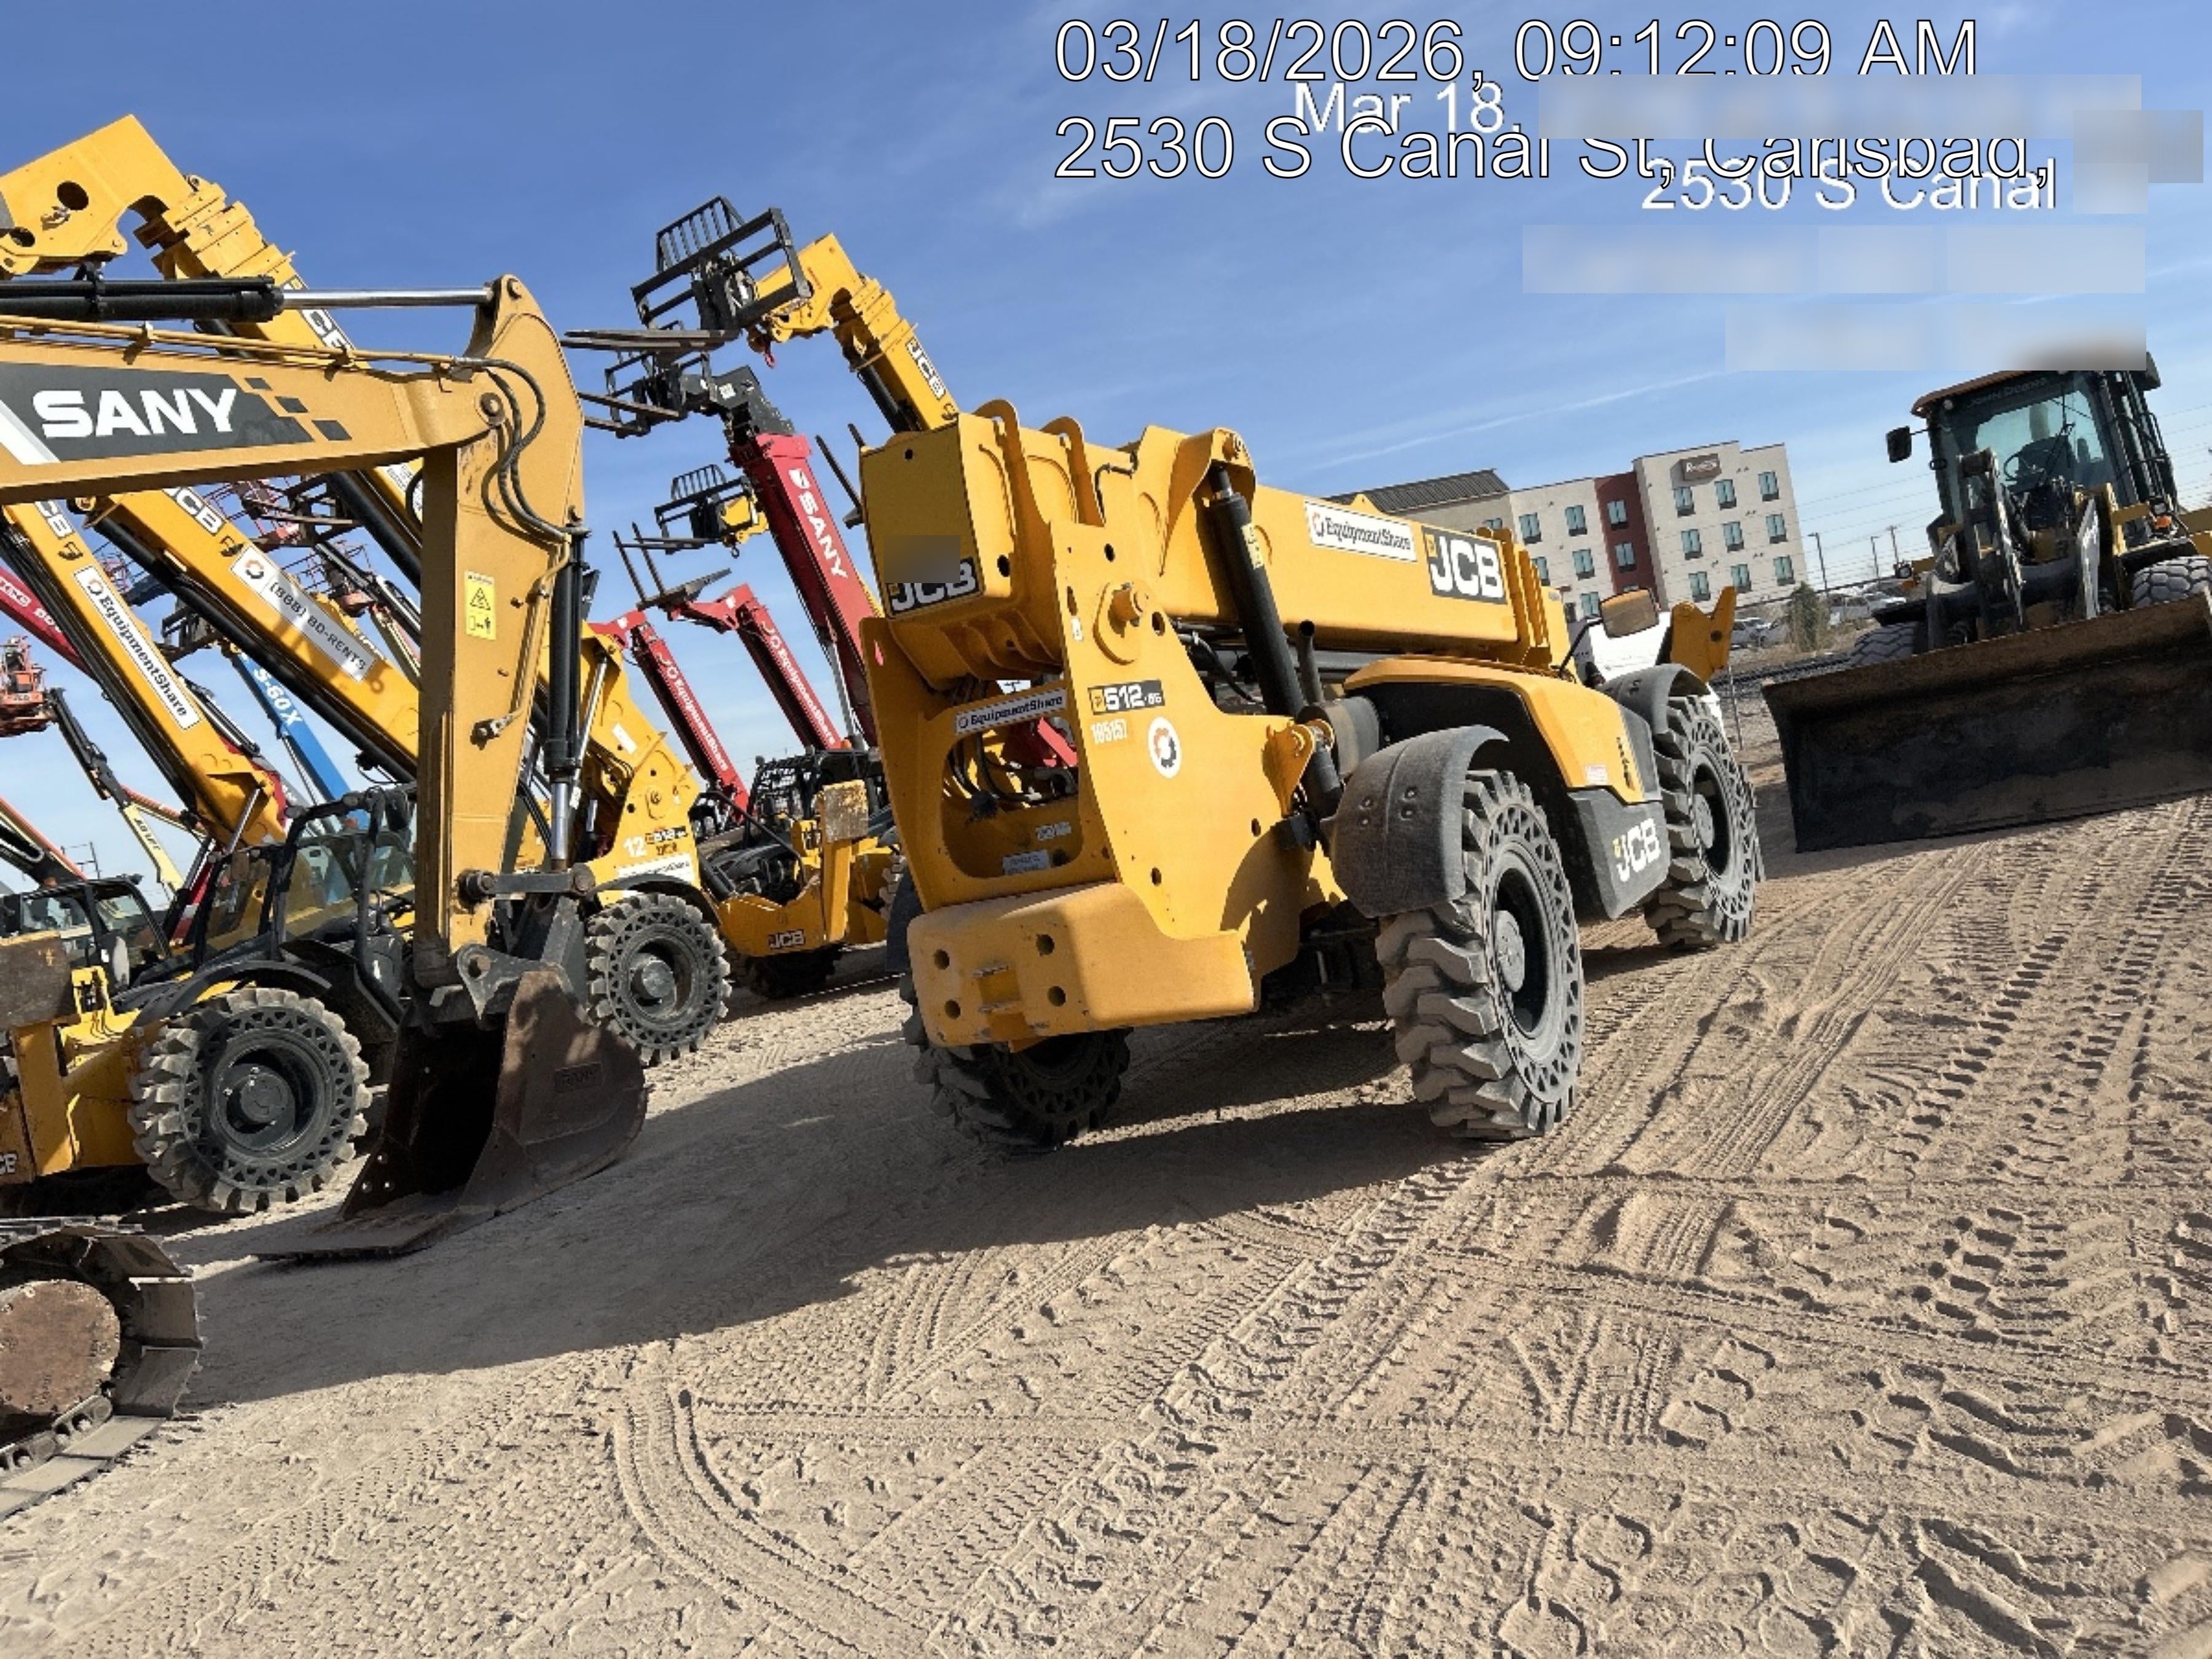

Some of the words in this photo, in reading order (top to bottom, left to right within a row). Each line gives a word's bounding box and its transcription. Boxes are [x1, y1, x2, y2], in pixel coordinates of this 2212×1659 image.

[33, 388, 237, 438] SANY
[798, 490, 849, 579] SANY
[1325, 517, 1411, 550] EquipmentShare
[1430, 535, 1505, 598] JCB
[99, 595, 187, 716] EquipmentShare
[970, 696, 1063, 726] EquipmentShare
[1616, 818, 1661, 882] JCB
[769, 930, 805, 949] JCB
